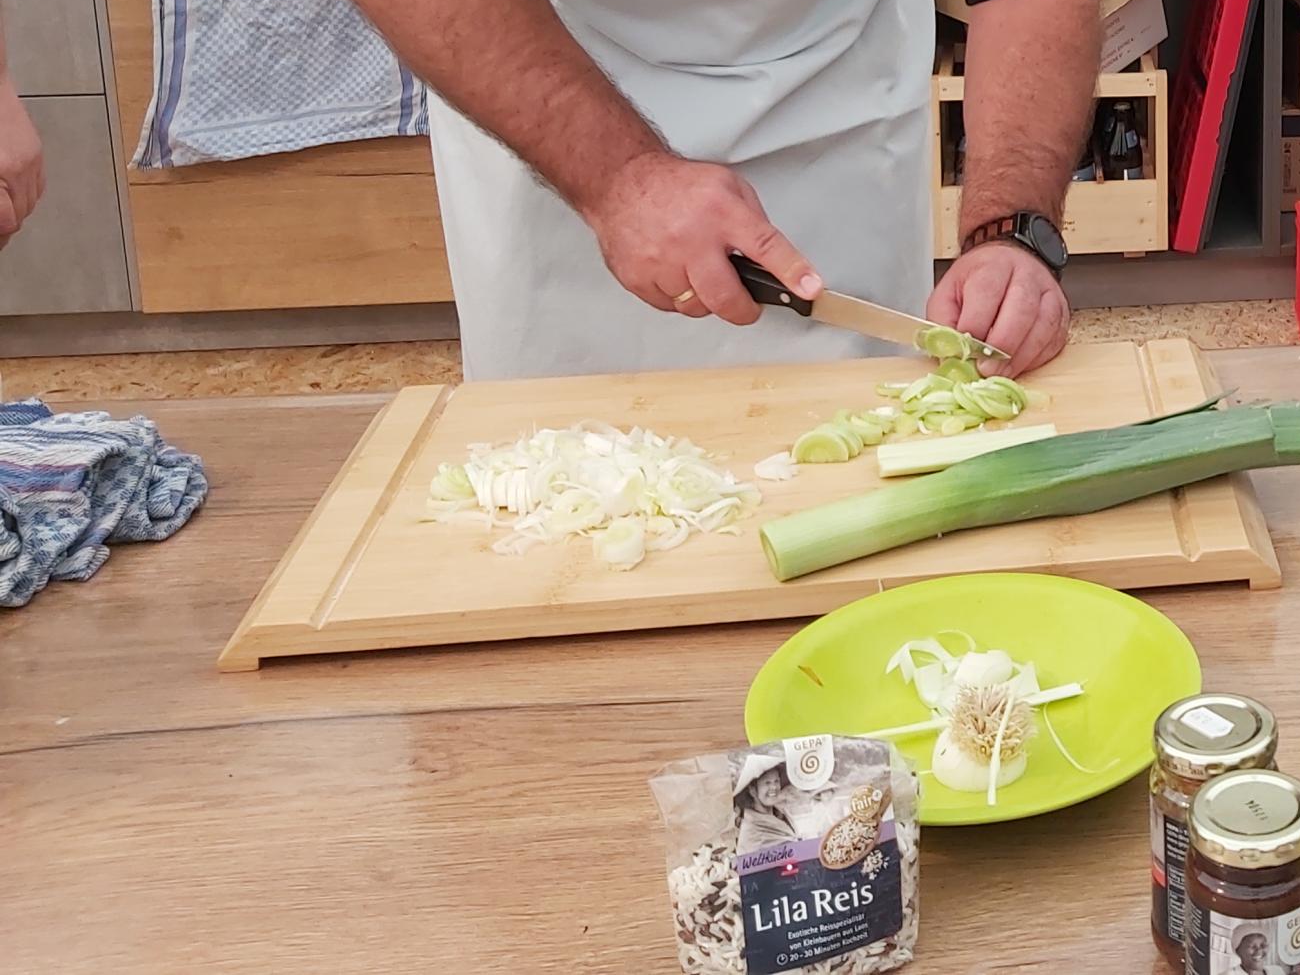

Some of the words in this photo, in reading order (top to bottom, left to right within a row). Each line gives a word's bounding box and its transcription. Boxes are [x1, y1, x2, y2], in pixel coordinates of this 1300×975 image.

[751, 895, 808, 932] Lila
[810, 881, 874, 918] Reis
[803, 932, 841, 947] Kleinbauern
